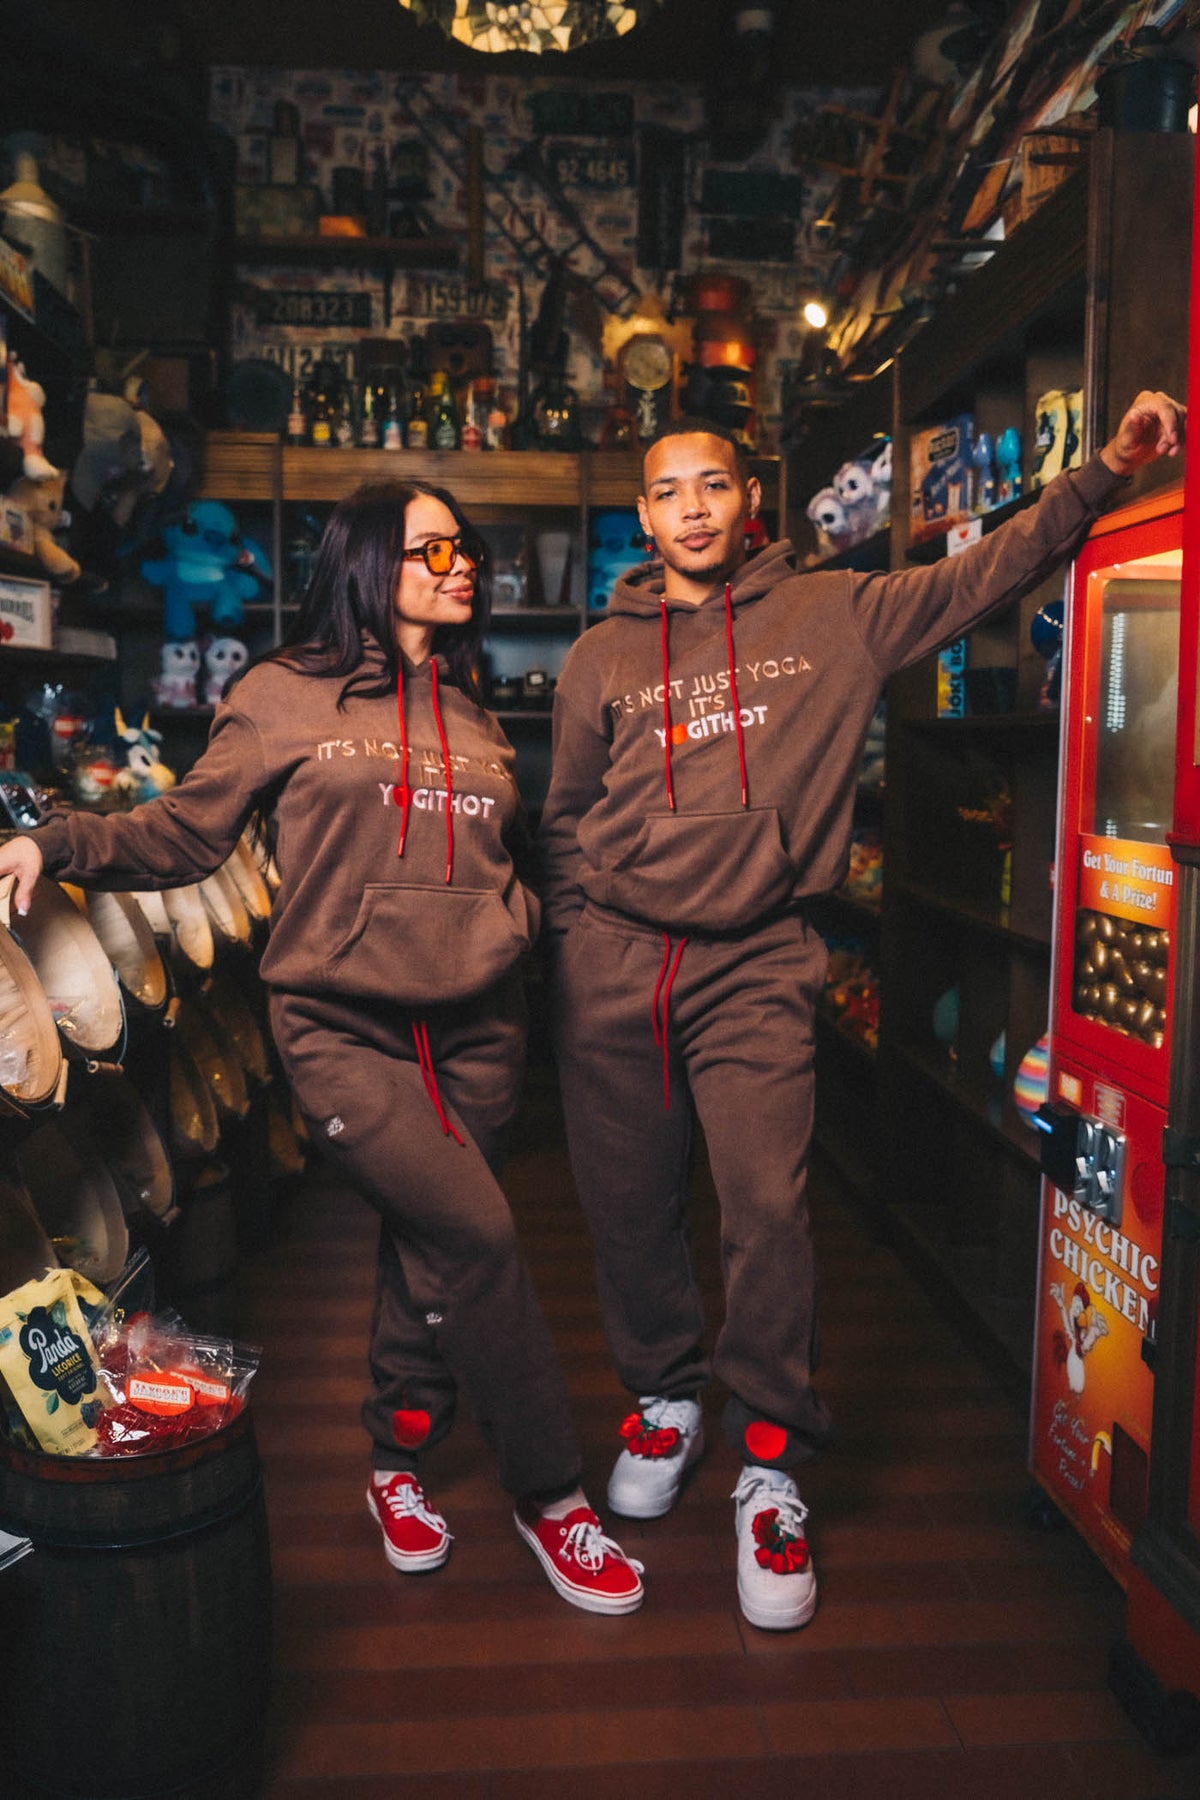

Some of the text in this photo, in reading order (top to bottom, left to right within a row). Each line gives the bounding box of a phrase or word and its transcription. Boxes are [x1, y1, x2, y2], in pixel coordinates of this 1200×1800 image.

[950, 643, 963, 666] BO
[638, 679, 684, 708] NOT
[745, 656, 812, 682] YOGA
[689, 693, 726, 718] IT'S
[317, 739, 356, 761] IT'S
[1083, 849, 1173, 886] Get Your Fortun
[1099, 880, 1158, 911] & A Prize!
[1053, 1186, 1158, 1291] PSYCHIC
[1050, 1228, 1154, 1336] CHICKEN
[28, 1327, 79, 1374] Panda
[51, 1352, 83, 1377] LICORICE
